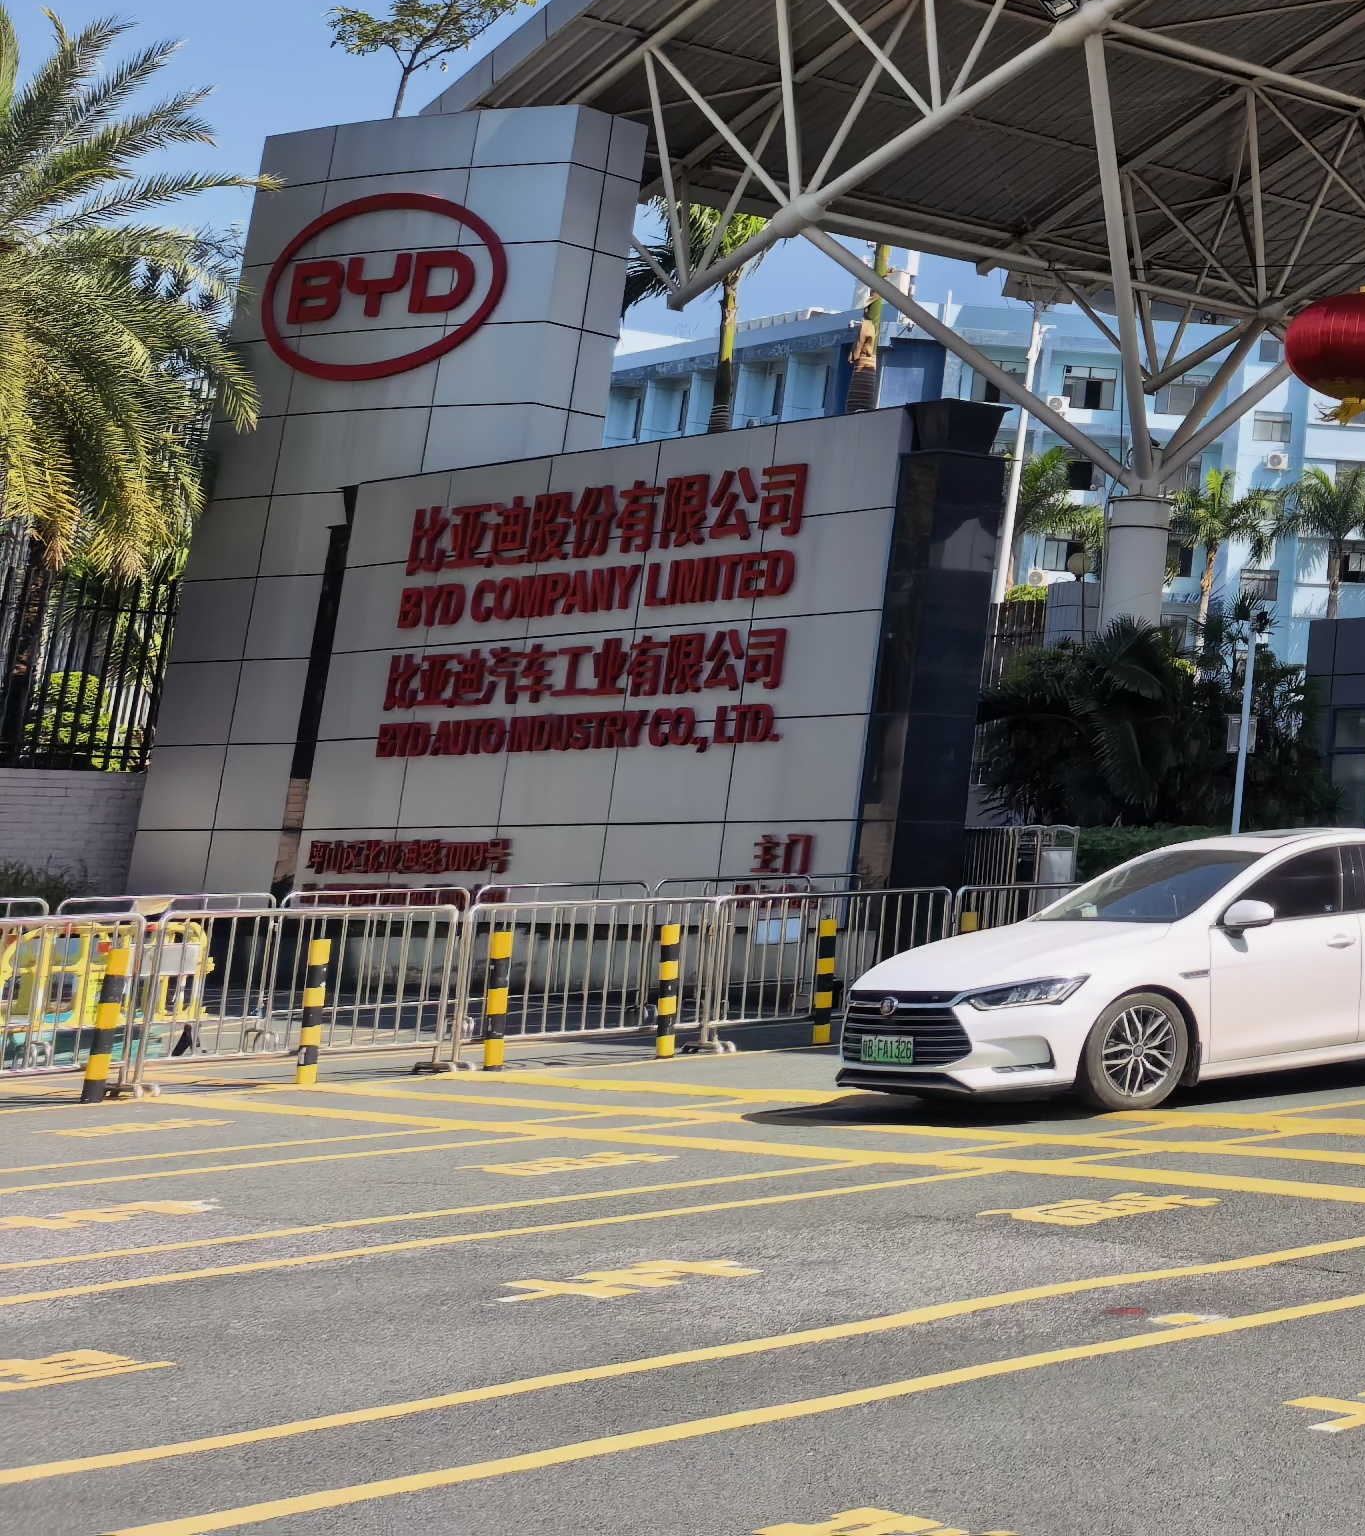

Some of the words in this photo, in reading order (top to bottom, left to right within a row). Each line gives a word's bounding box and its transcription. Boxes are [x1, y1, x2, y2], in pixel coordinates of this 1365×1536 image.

[286, 250, 476, 325] BYD
[406, 463, 808, 576] 比亚迪股份有限公司
[397, 583, 466, 629] BYD
[471, 564, 643, 623] COMPANY
[644, 549, 796, 607] LIMITED
[383, 627, 788, 712] 比亚迪汽车工业有限公司
[376, 721, 432, 758] BYD
[430, 717, 506, 756] AUTO
[507, 709, 650, 753] INDUSTRY
[713, 703, 781, 744] LTD.
[749, 833, 813, 875] 主门
